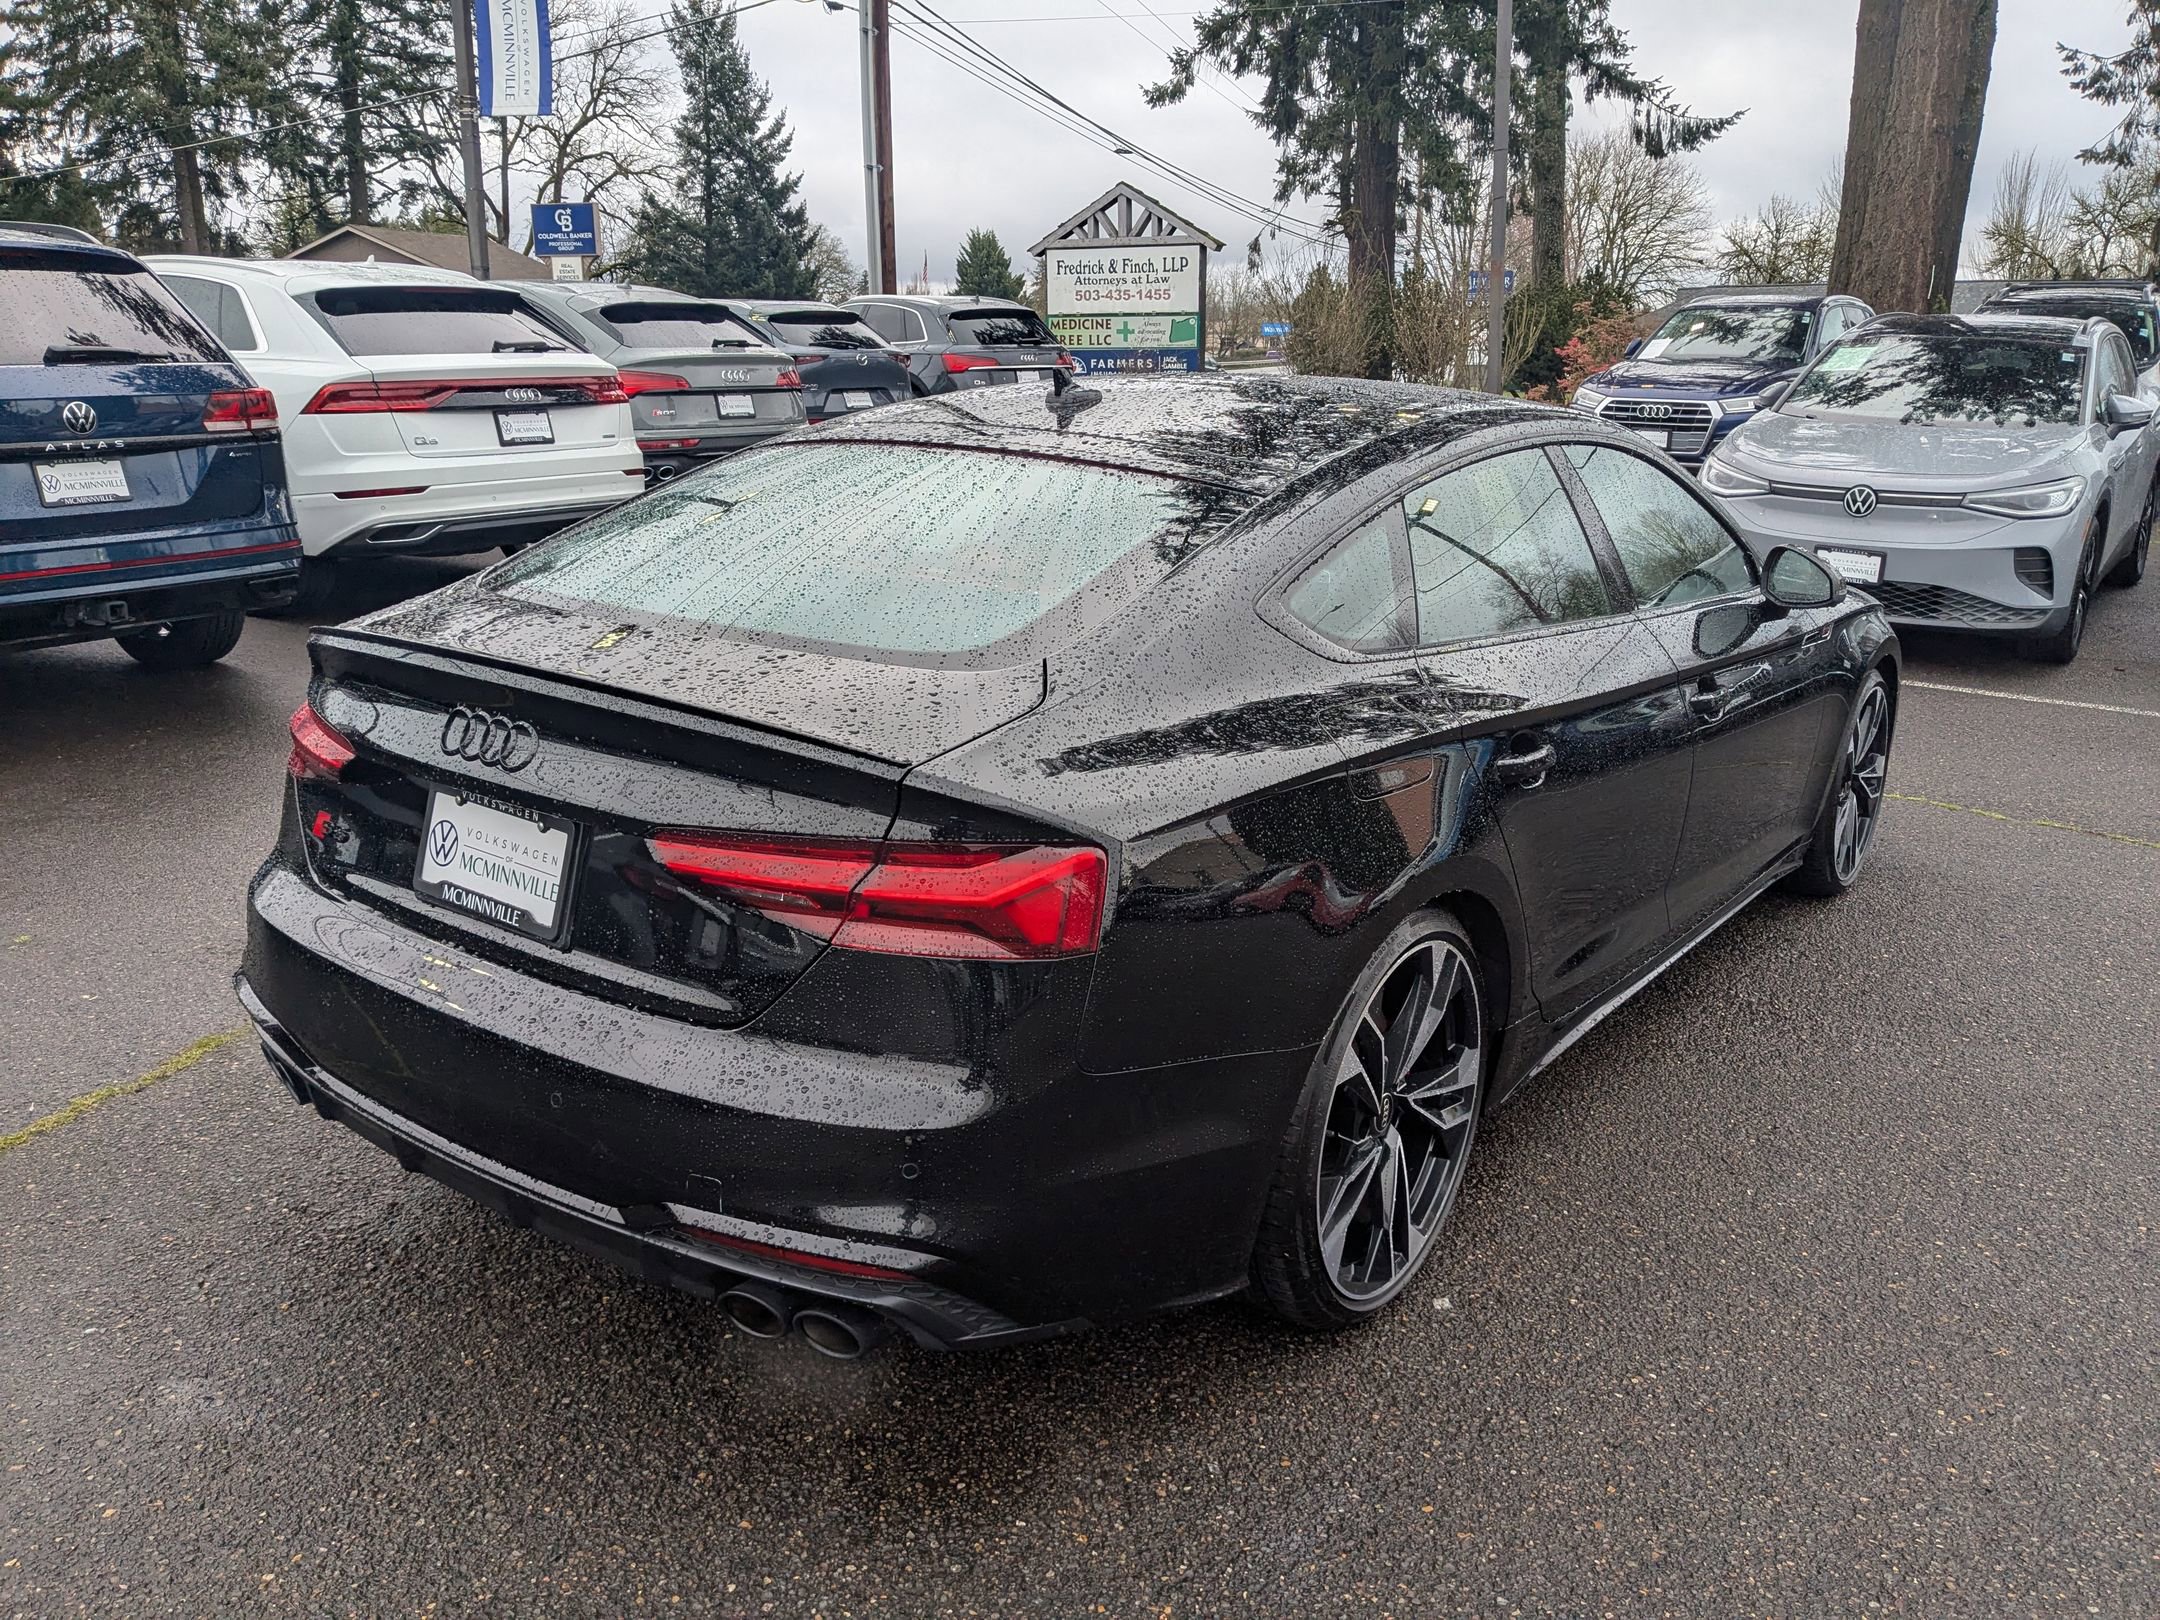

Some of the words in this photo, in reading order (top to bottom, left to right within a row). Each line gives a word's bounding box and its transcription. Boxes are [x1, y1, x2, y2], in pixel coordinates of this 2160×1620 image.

[501, 0, 515, 101] MCMINNVILLE
[1056, 259, 1105, 275] Fredrick
[1108, 258, 1119, 274] &
[1121, 257, 1159, 275] Finch,
[1162, 256, 1189, 273] LLP
[1074, 275, 1128, 286] Attorneys
[1131, 276, 1143, 284] at
[1146, 274, 1171, 284] Law
[1075, 288, 1172, 301] 503-435-1455
[1050, 318, 1112, 330] MEDICINE
[1089, 335, 1112, 345] LLC
[1091, 359, 1153, 369] FARMERS
[45, 440, 125, 452] ATLAS
[61, 469, 119, 477] VOLKSWAGEN
[64, 479, 126, 491] MCMINNVILLE
[1836, 565, 1878, 577] CMINNVILLE
[461, 790, 539, 822] VOLKSWAGEN
[466, 827, 559, 867] VOLKSWAGEN
[459, 851, 560, 903] MCMINNVILLE
[442, 884, 522, 927] MCMINNVILLE
